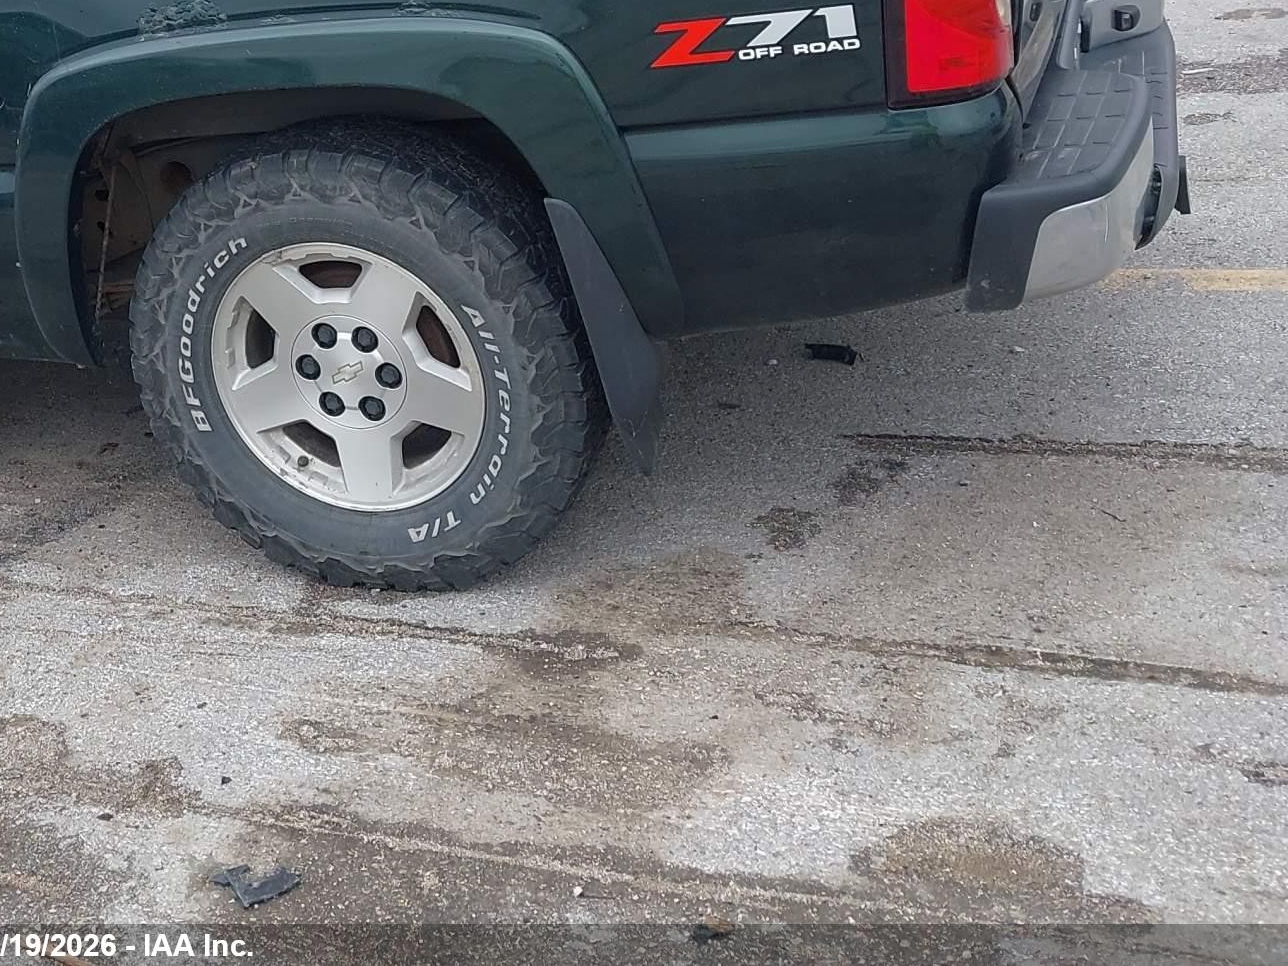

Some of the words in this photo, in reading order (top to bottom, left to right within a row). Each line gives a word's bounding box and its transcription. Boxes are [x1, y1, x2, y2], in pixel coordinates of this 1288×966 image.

[650, 4, 858, 68] Z71
[738, 46, 782, 61] OFF
[793, 38, 861, 56] ROAD
[178, 237, 249, 432] BFGoodrich
[462, 305, 511, 505] All-Terrain
[408, 510, 461, 543] T/A
